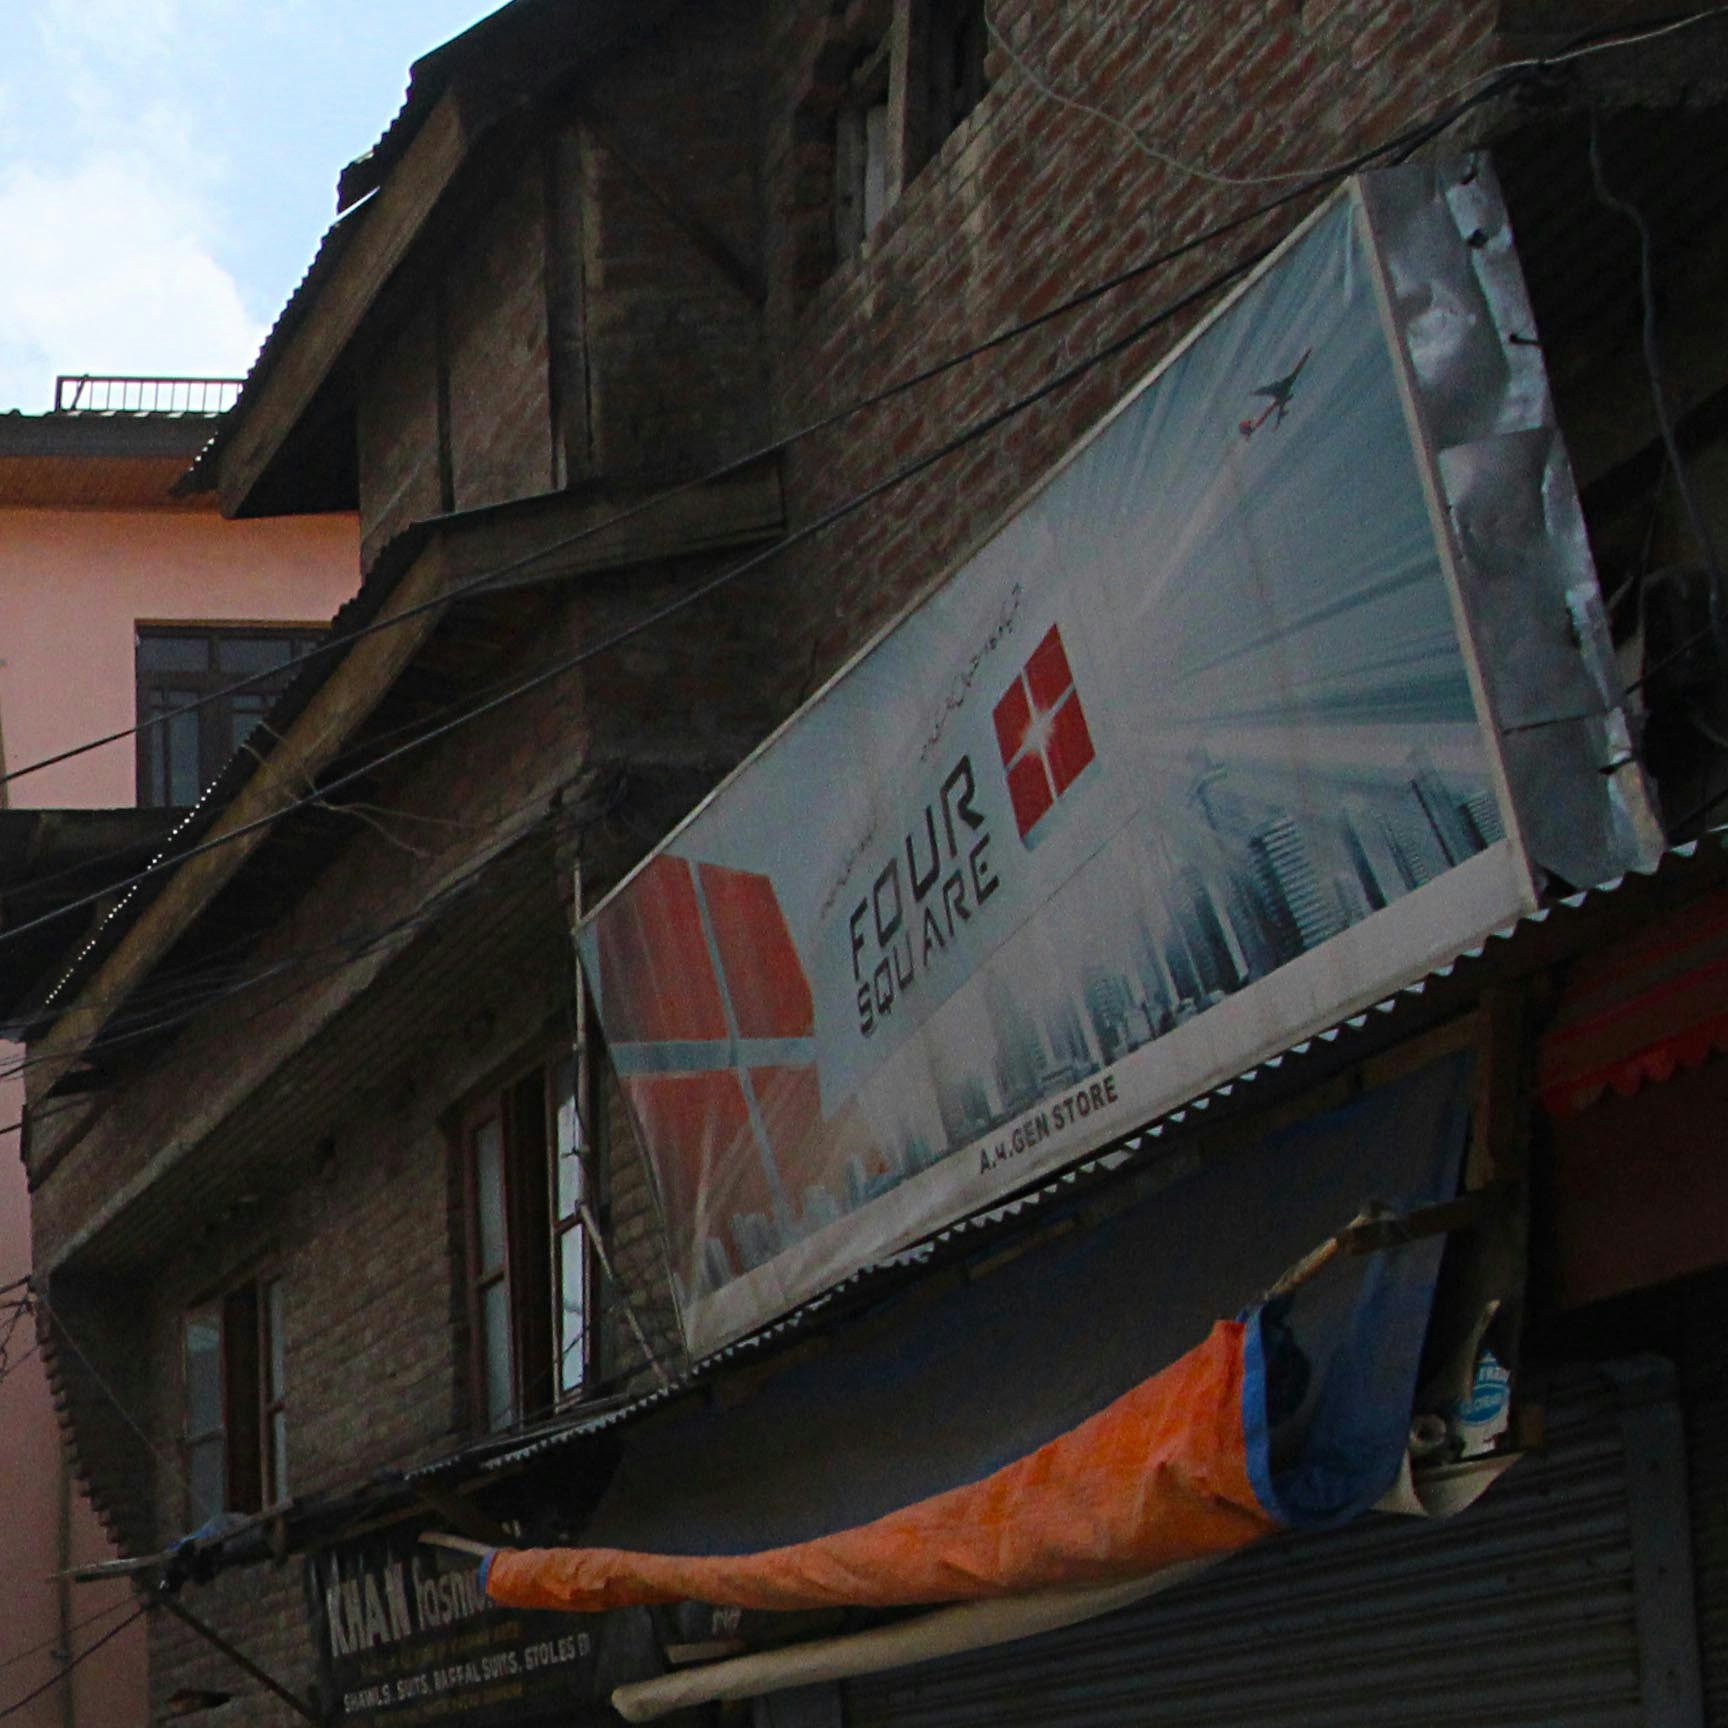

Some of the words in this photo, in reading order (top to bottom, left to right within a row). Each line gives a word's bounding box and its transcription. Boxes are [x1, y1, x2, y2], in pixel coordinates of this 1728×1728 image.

[850, 754, 984, 981] FOUR
[857, 833, 1000, 1037] SQUARE
[1052, 1074, 1118, 1131] STORE
[326, 1562, 411, 1658] KHAN
